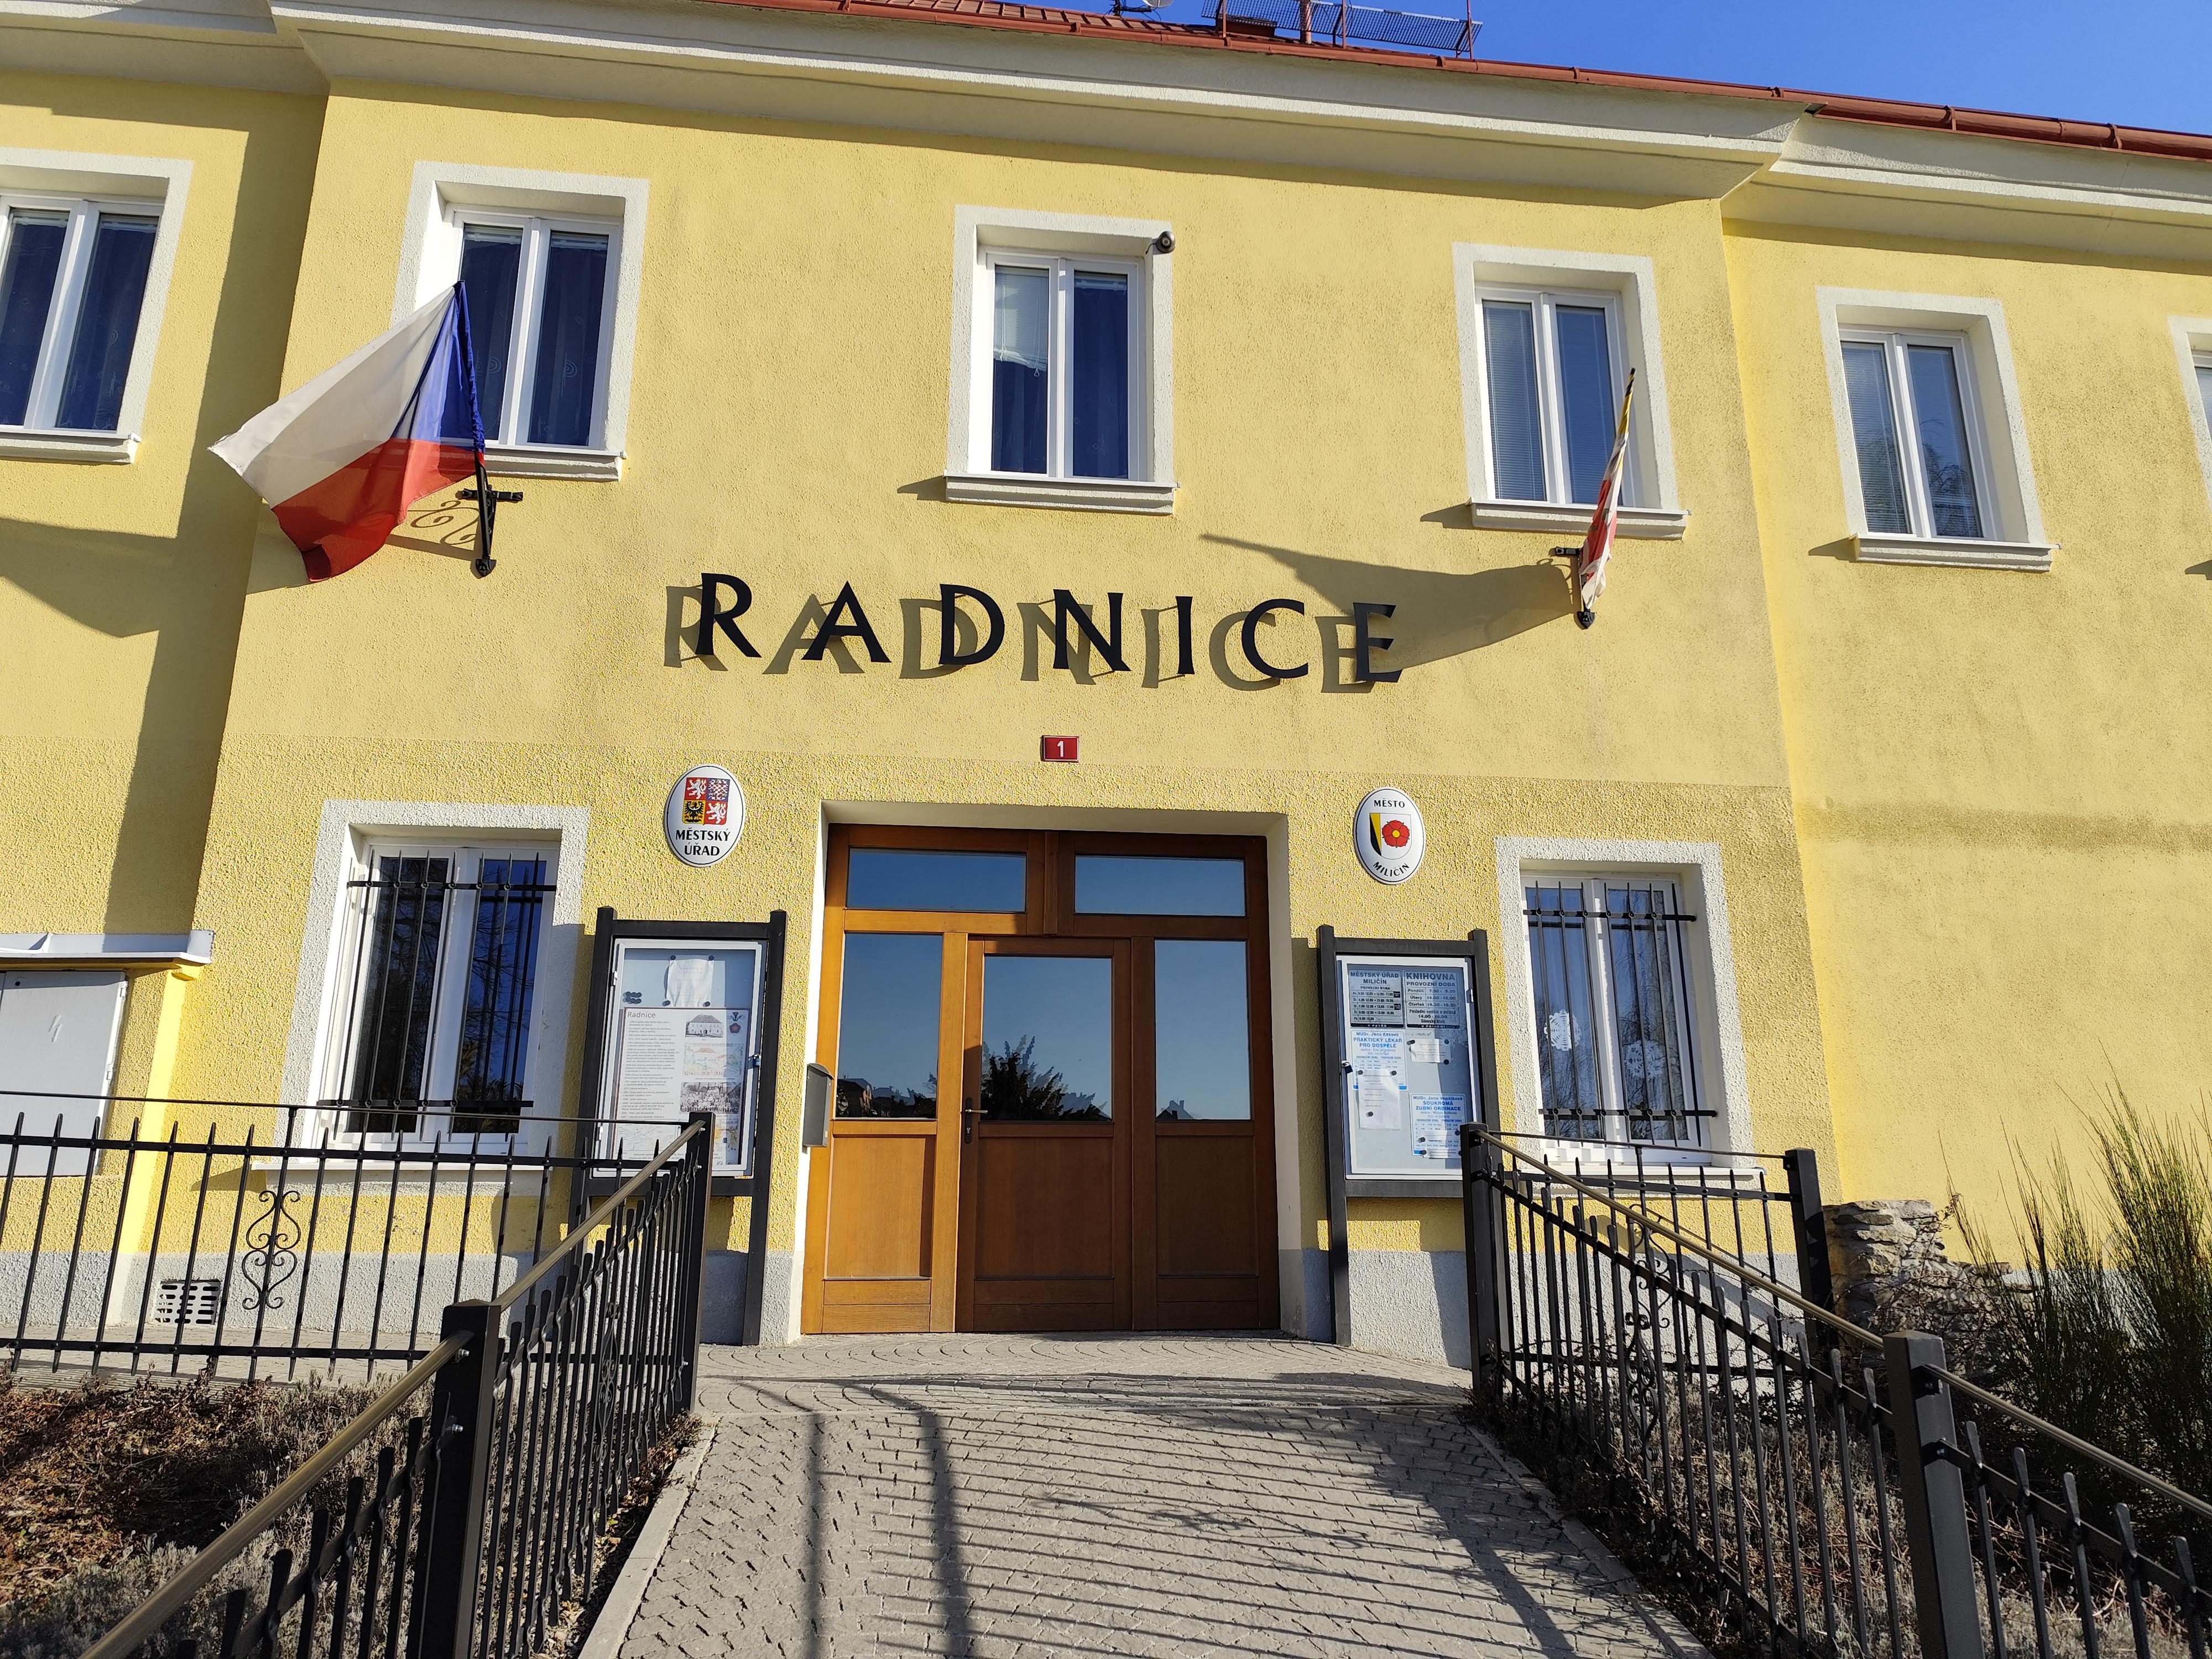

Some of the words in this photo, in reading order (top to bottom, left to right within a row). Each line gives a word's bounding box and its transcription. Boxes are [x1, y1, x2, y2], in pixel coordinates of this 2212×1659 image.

[695, 572, 1403, 682] RADNICE
[1057, 741, 1063, 757] 1
[1374, 798, 1405, 807] MĚSTO
[676, 827, 731, 841] MĚSTSKÝ
[685, 842, 719, 855] ÚŘAD
[1373, 862, 1409, 877] MILIČÍN
